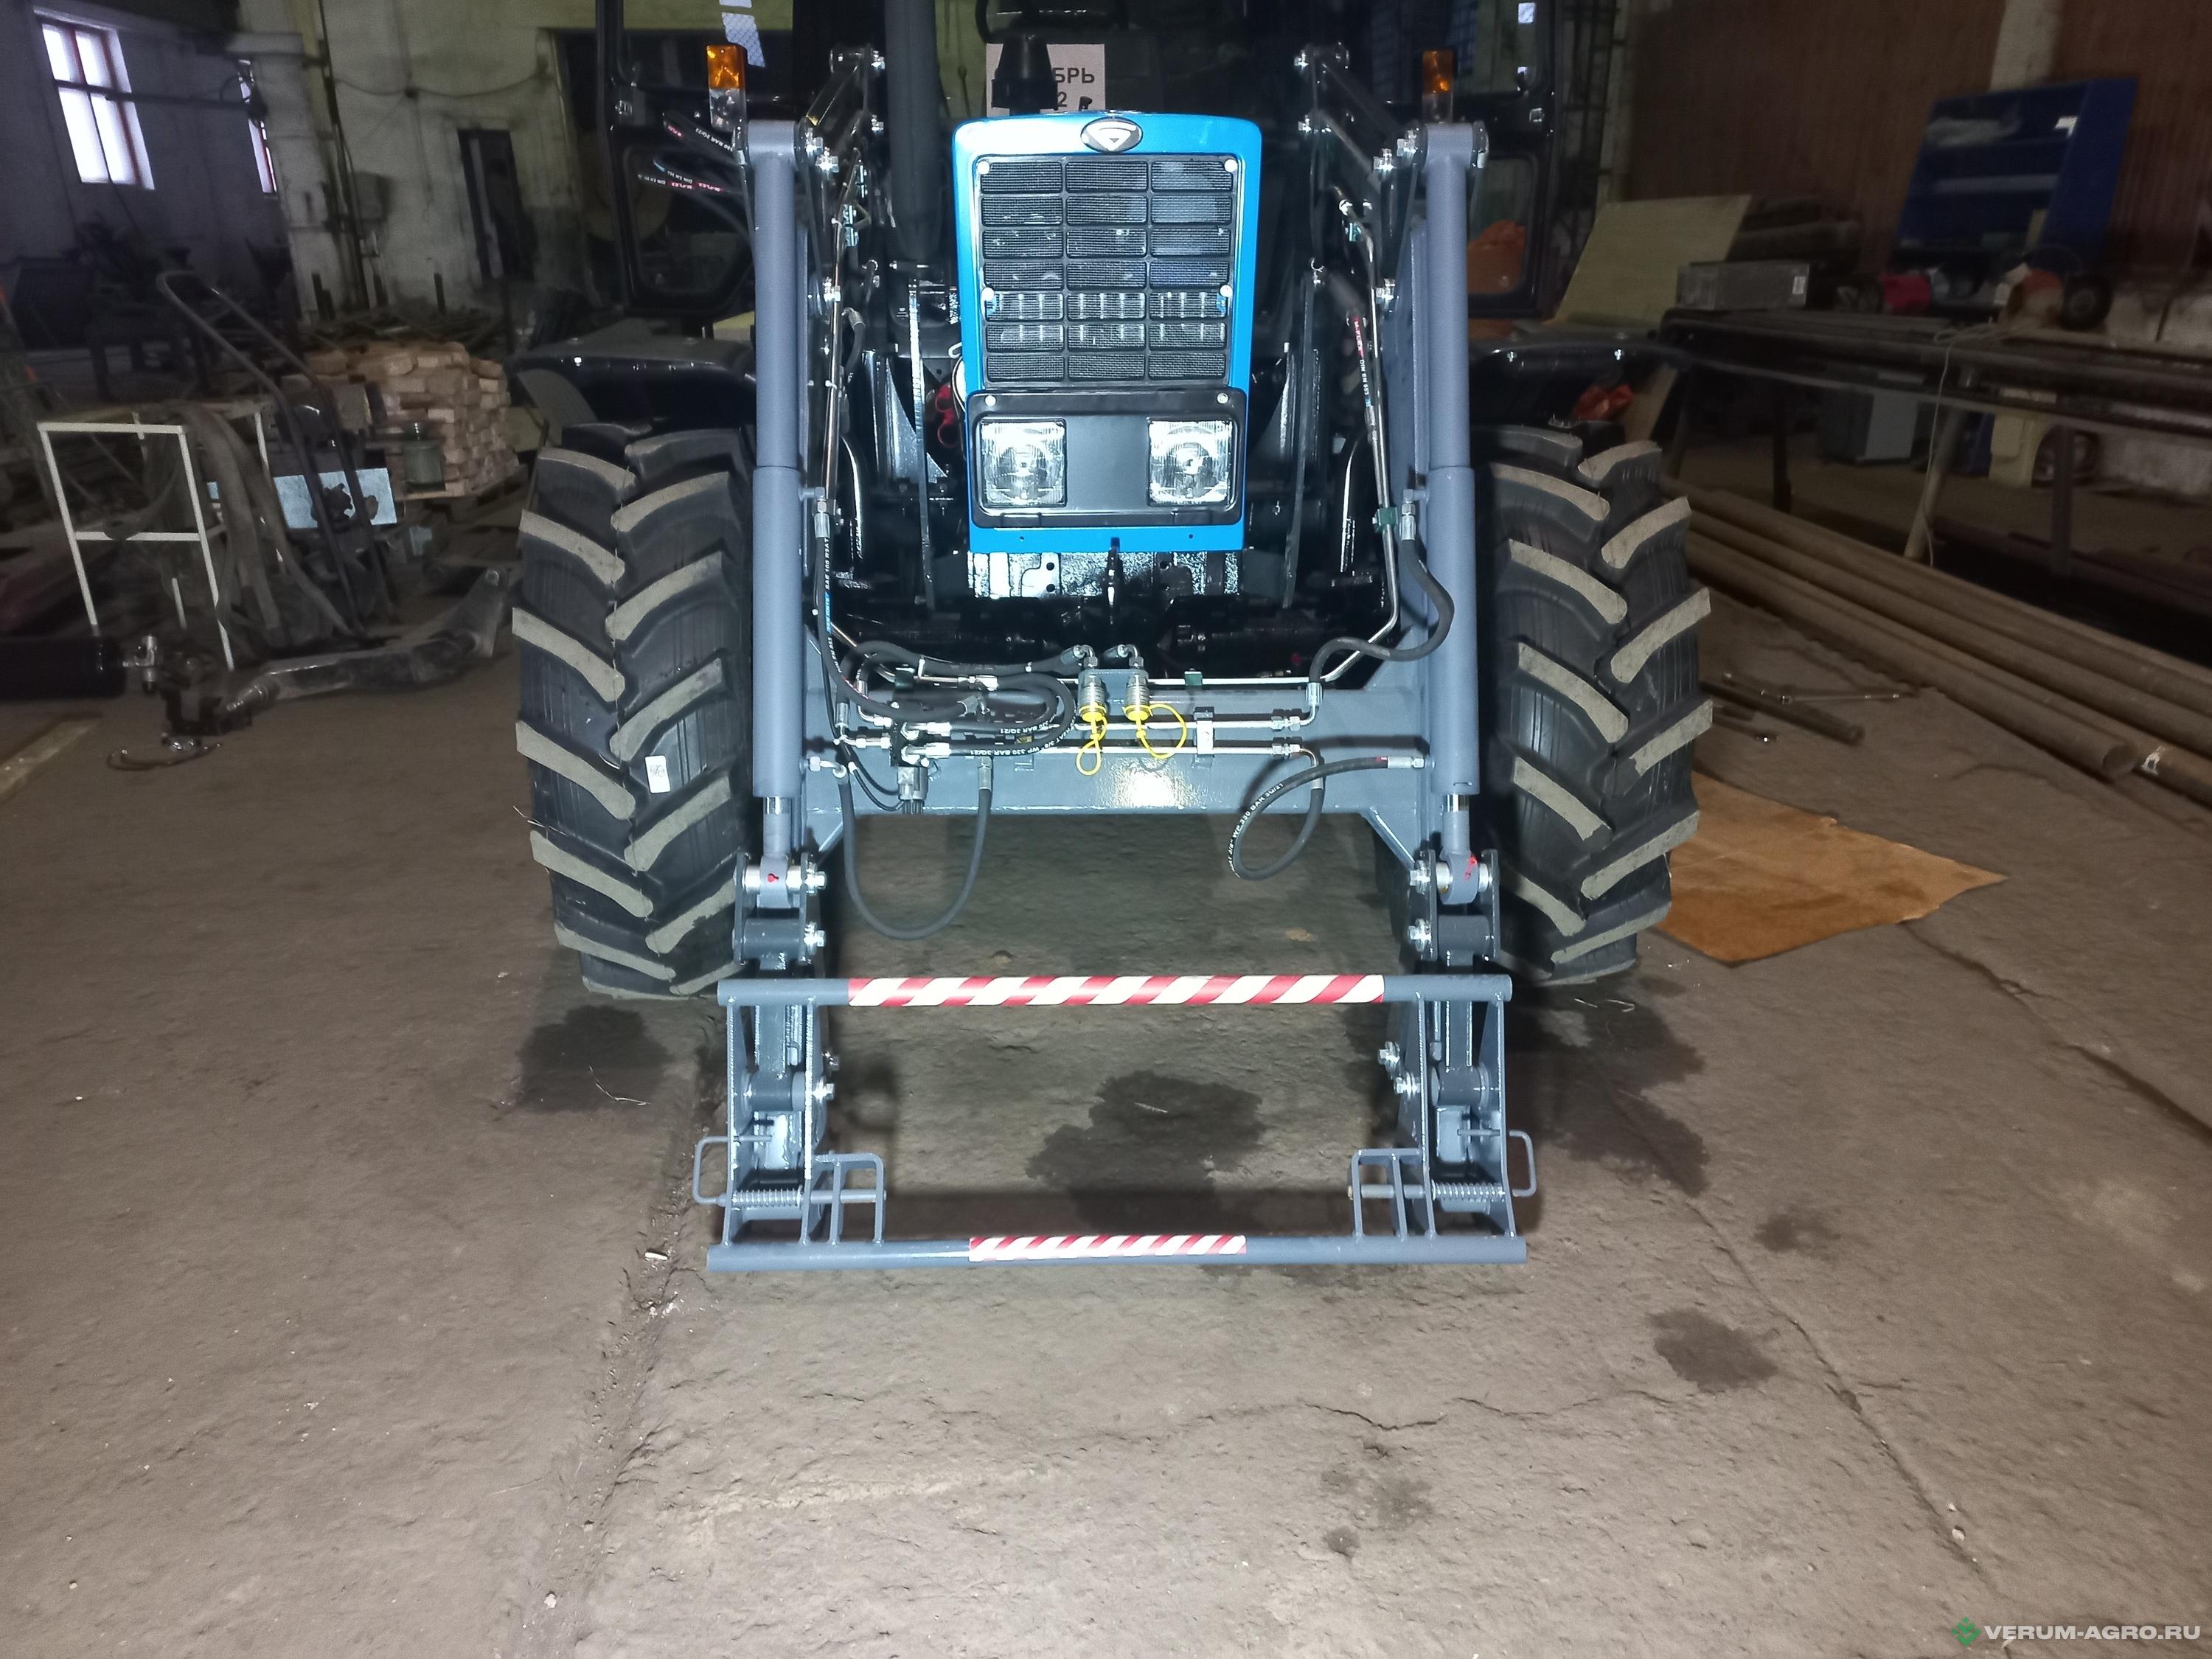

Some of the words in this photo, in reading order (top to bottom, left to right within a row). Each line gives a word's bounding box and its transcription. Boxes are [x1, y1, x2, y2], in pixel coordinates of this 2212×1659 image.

[1052, 67, 1095, 83] БРЬ
[1361, 373, 1368, 383] EN
[1232, 824, 1241, 838] WP
[1250, 796, 1265, 811] BAR
[1265, 782, 1284, 797] 3Q/21
